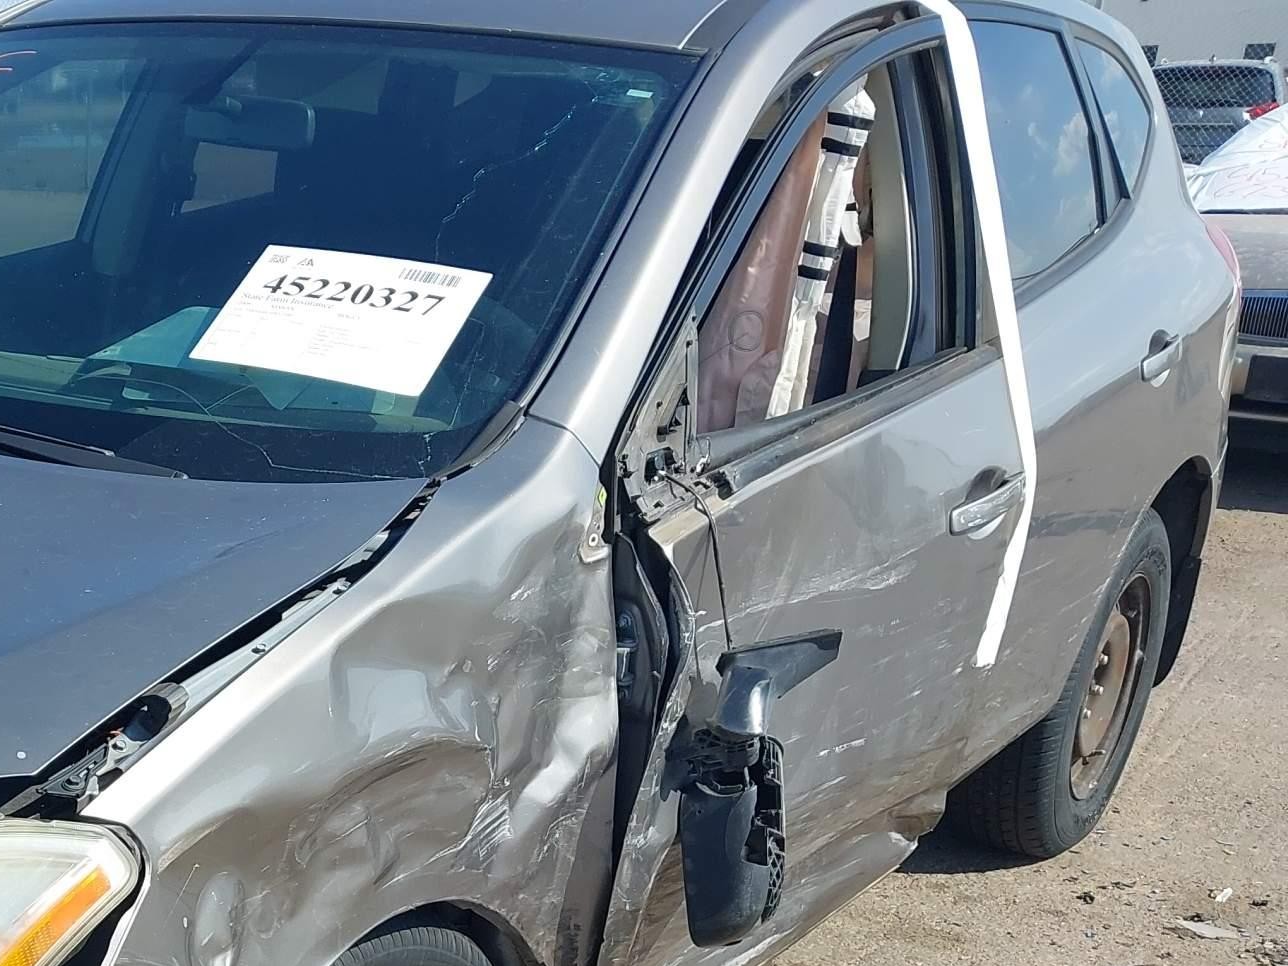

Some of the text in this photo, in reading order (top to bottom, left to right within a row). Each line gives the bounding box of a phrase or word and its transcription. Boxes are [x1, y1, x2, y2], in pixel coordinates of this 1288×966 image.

[241, 292, 264, 301] State
[265, 294, 289, 304] Farm
[289, 297, 336, 309] Insurance
[263, 274, 446, 317] 45220327
